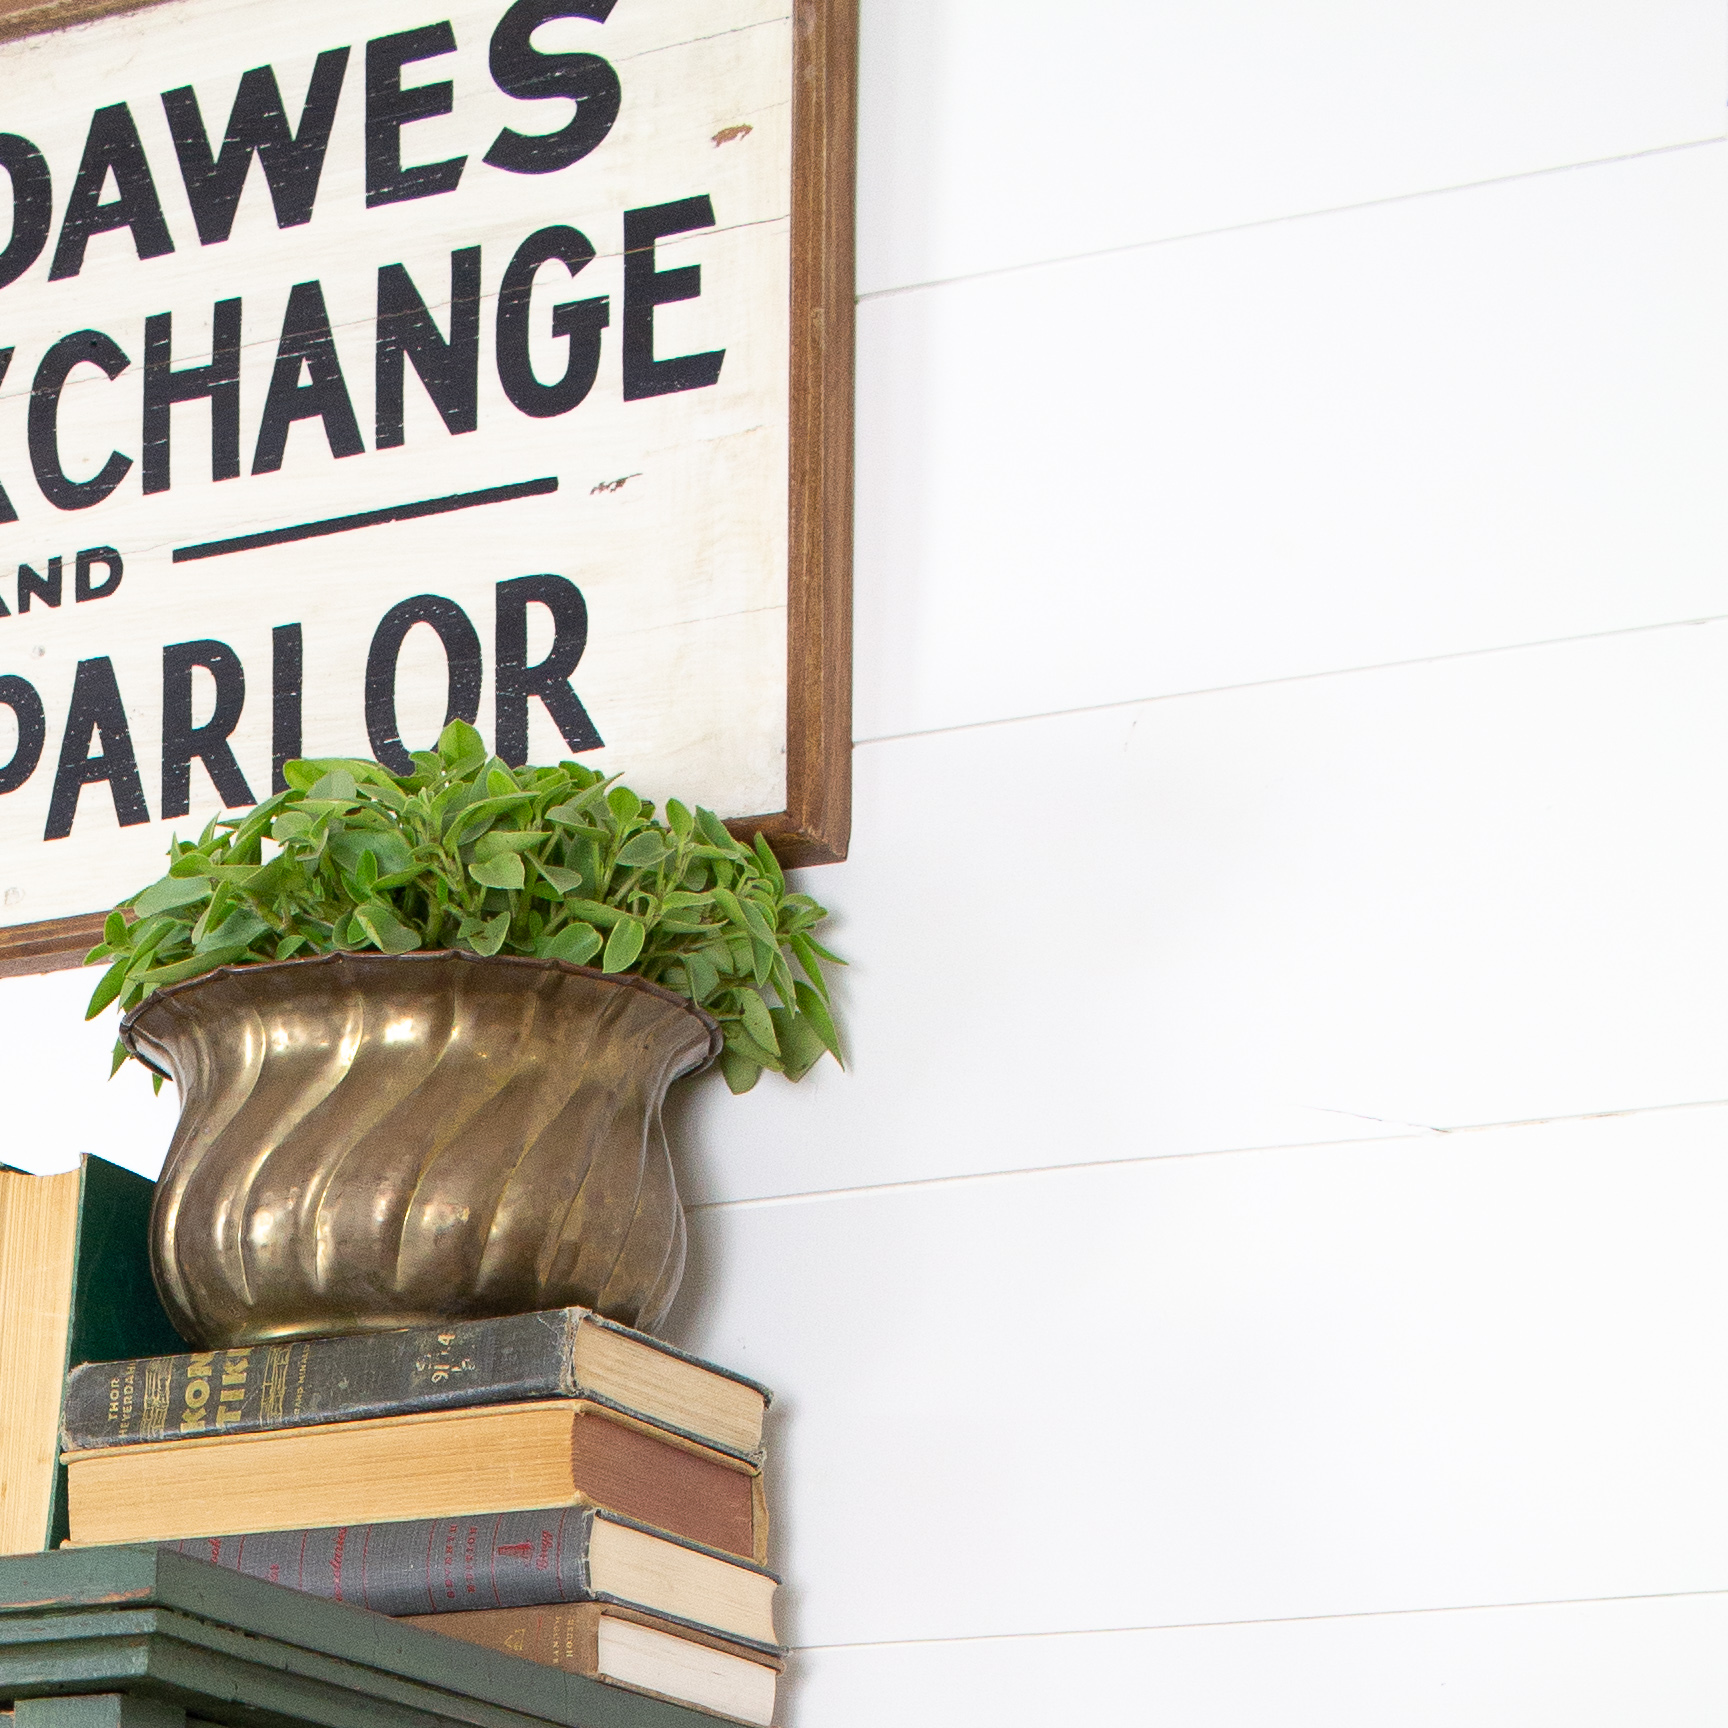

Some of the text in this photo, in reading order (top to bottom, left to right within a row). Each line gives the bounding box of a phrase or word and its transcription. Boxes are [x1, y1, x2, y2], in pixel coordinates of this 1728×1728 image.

[107, 1377, 120, 1421] THOR
[180, 1352, 215, 1433] KON
[215, 1347, 252, 1429] TIKI
[444, 1524, 458, 1599] SEVENTH
[465, 1526, 478, 1594] EDITION
[566, 1616, 575, 1658] HOUSE
